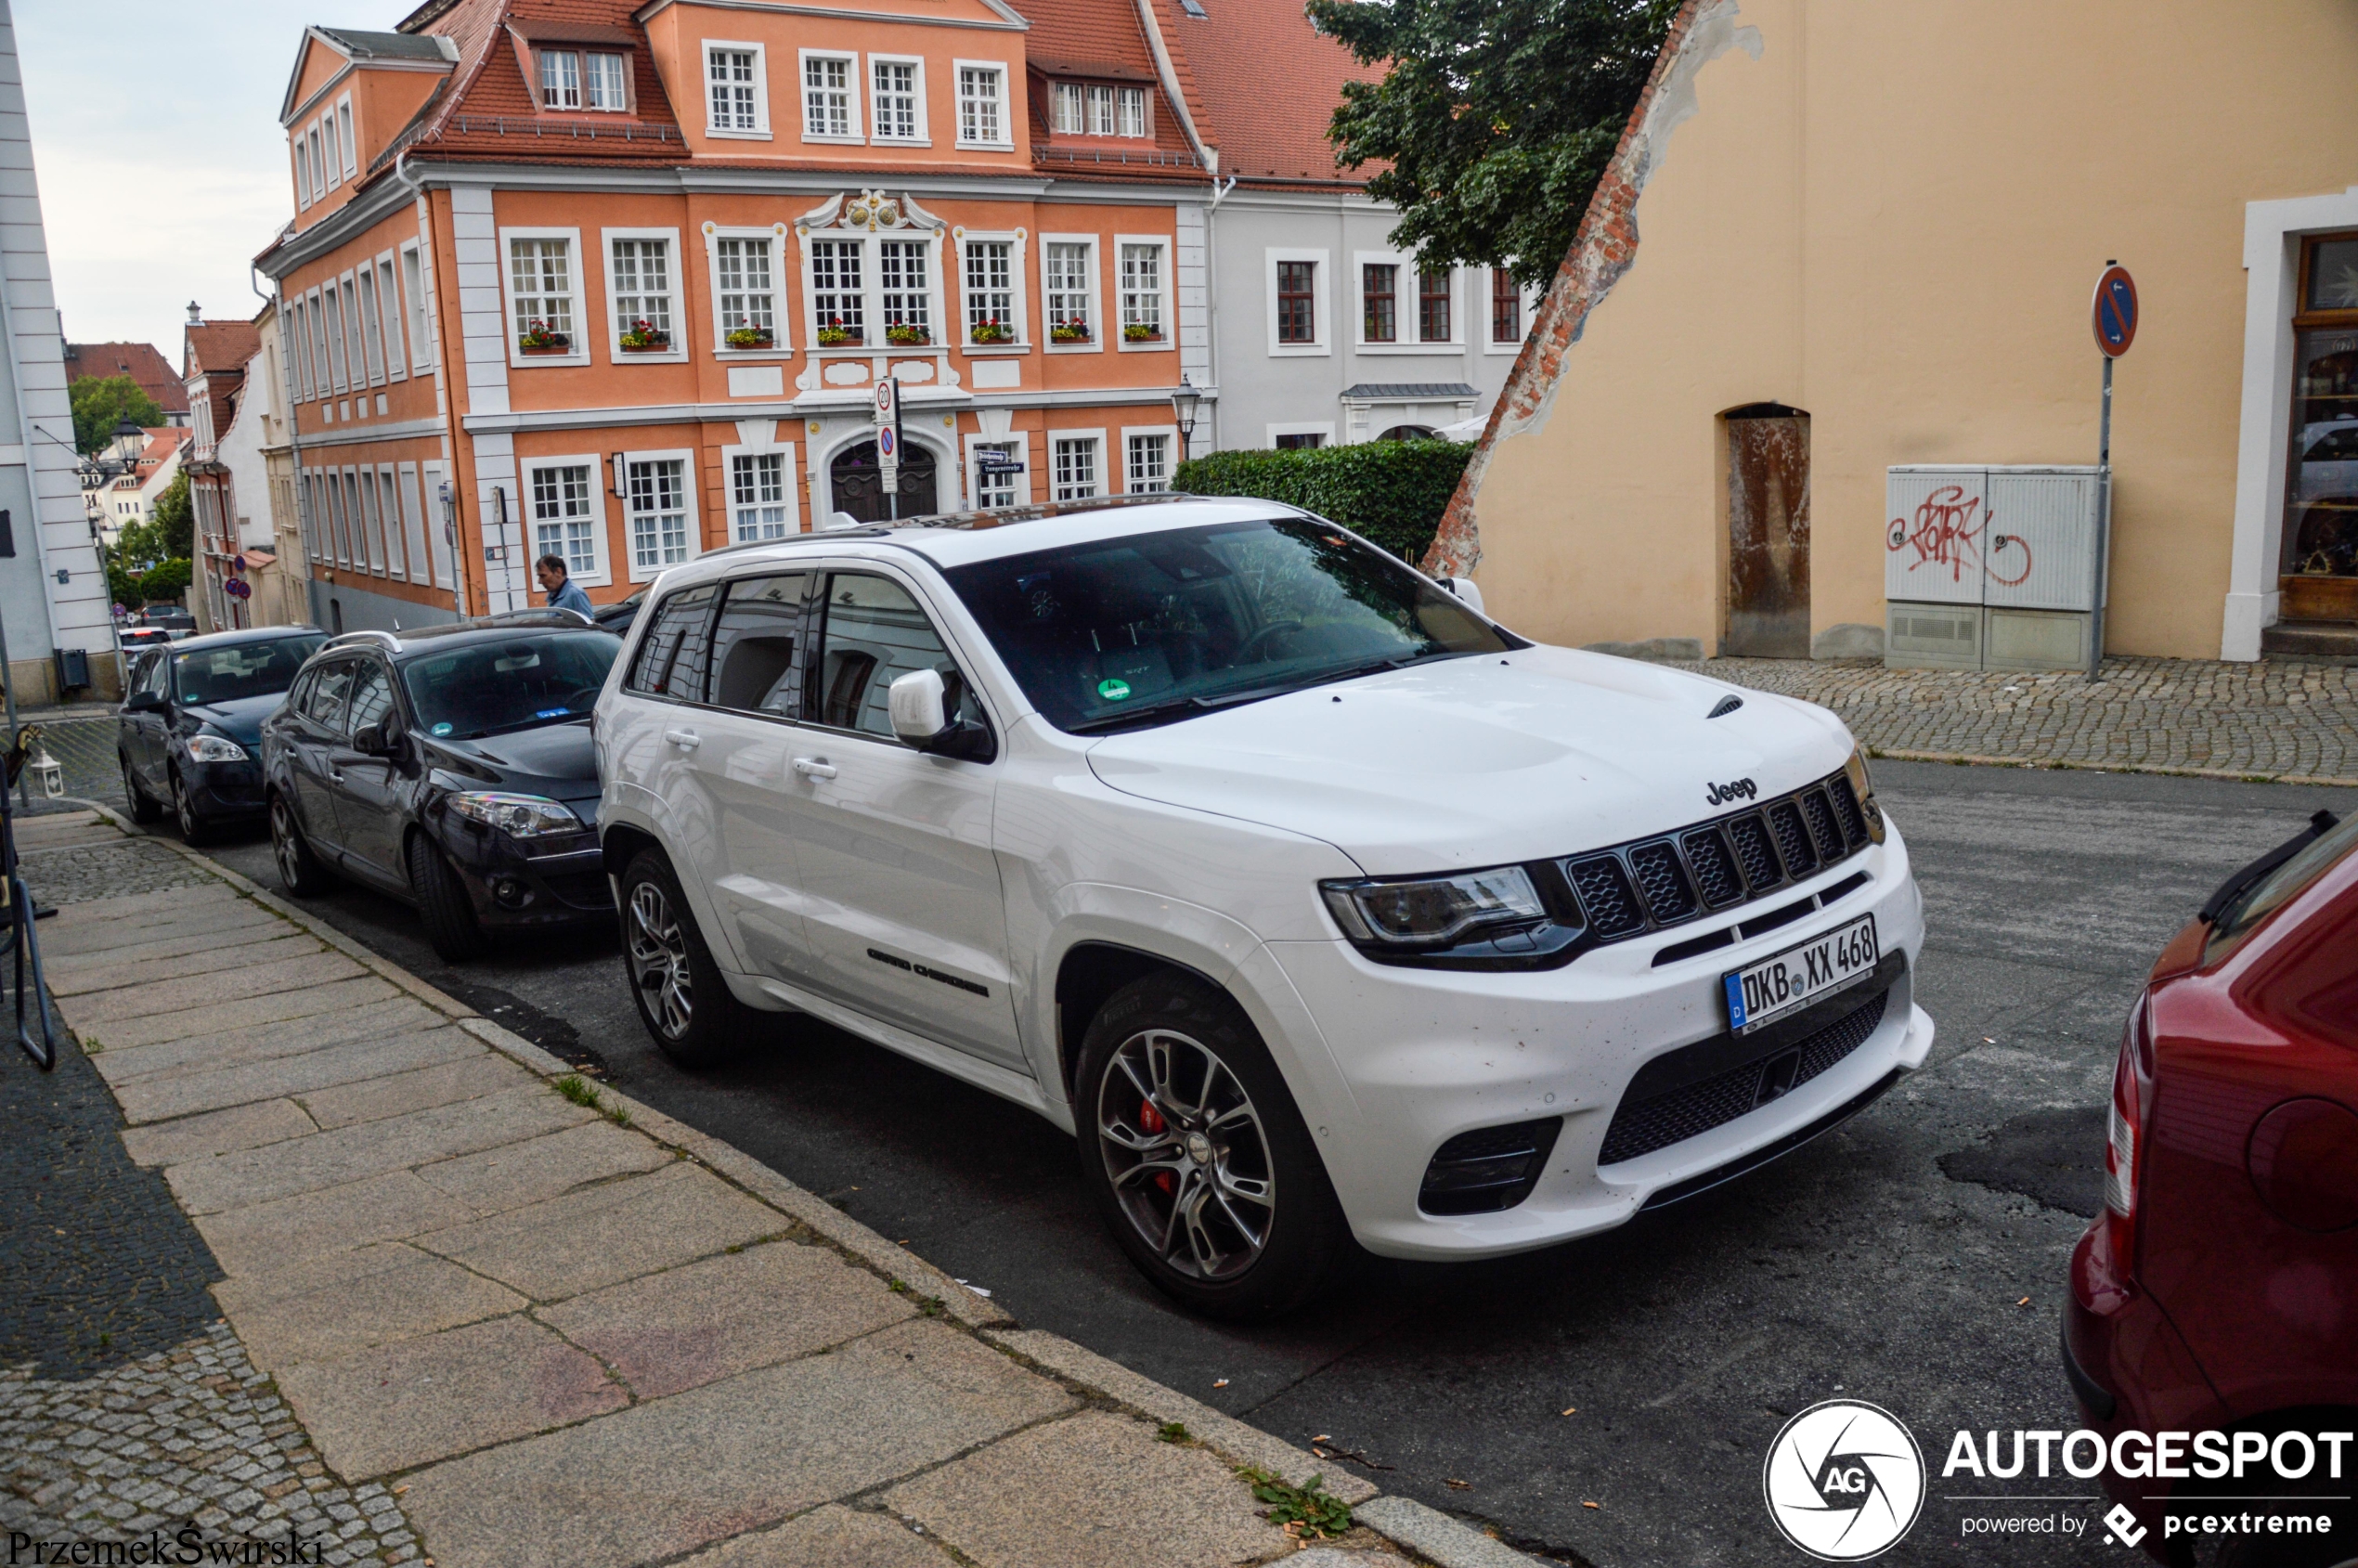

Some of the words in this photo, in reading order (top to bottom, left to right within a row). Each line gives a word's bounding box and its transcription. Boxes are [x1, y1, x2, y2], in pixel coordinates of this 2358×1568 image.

[879, 390, 888, 403] 20
[880, 412, 890, 421] ZONE
[1108, 680, 1118, 690] 4
[1706, 777, 1757, 806] Jeep
[1742, 962, 1790, 1017] DKB
[1803, 941, 1834, 990] XX
[1837, 925, 1873, 972] 468
[1733, 1006, 1742, 1018] D
